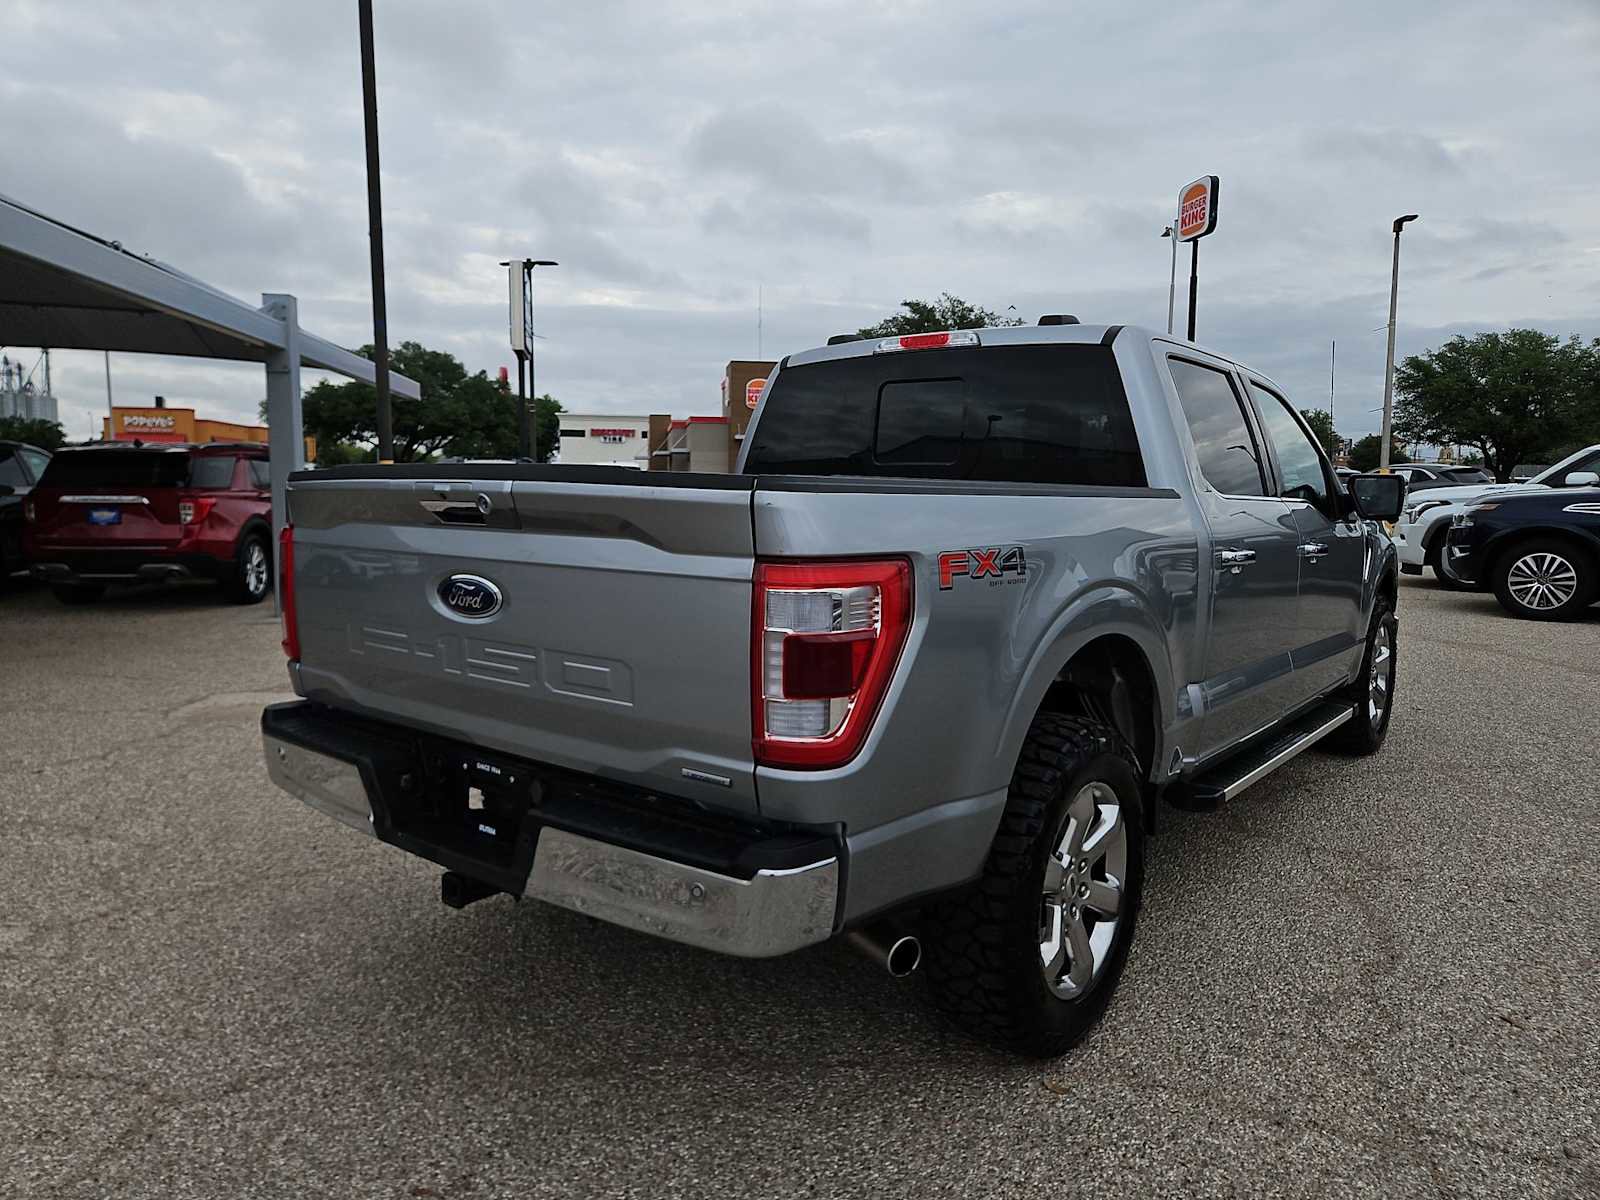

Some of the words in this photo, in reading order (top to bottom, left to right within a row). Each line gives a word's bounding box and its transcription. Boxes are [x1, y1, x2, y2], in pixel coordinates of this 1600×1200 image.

[1180, 206, 1206, 229] KING
[1181, 195, 1207, 216] BURGER
[748, 394, 758, 403] KI
[937, 547, 1026, 590] FX4
[449, 582, 484, 609] Ford
[347, 622, 634, 707] F-150
